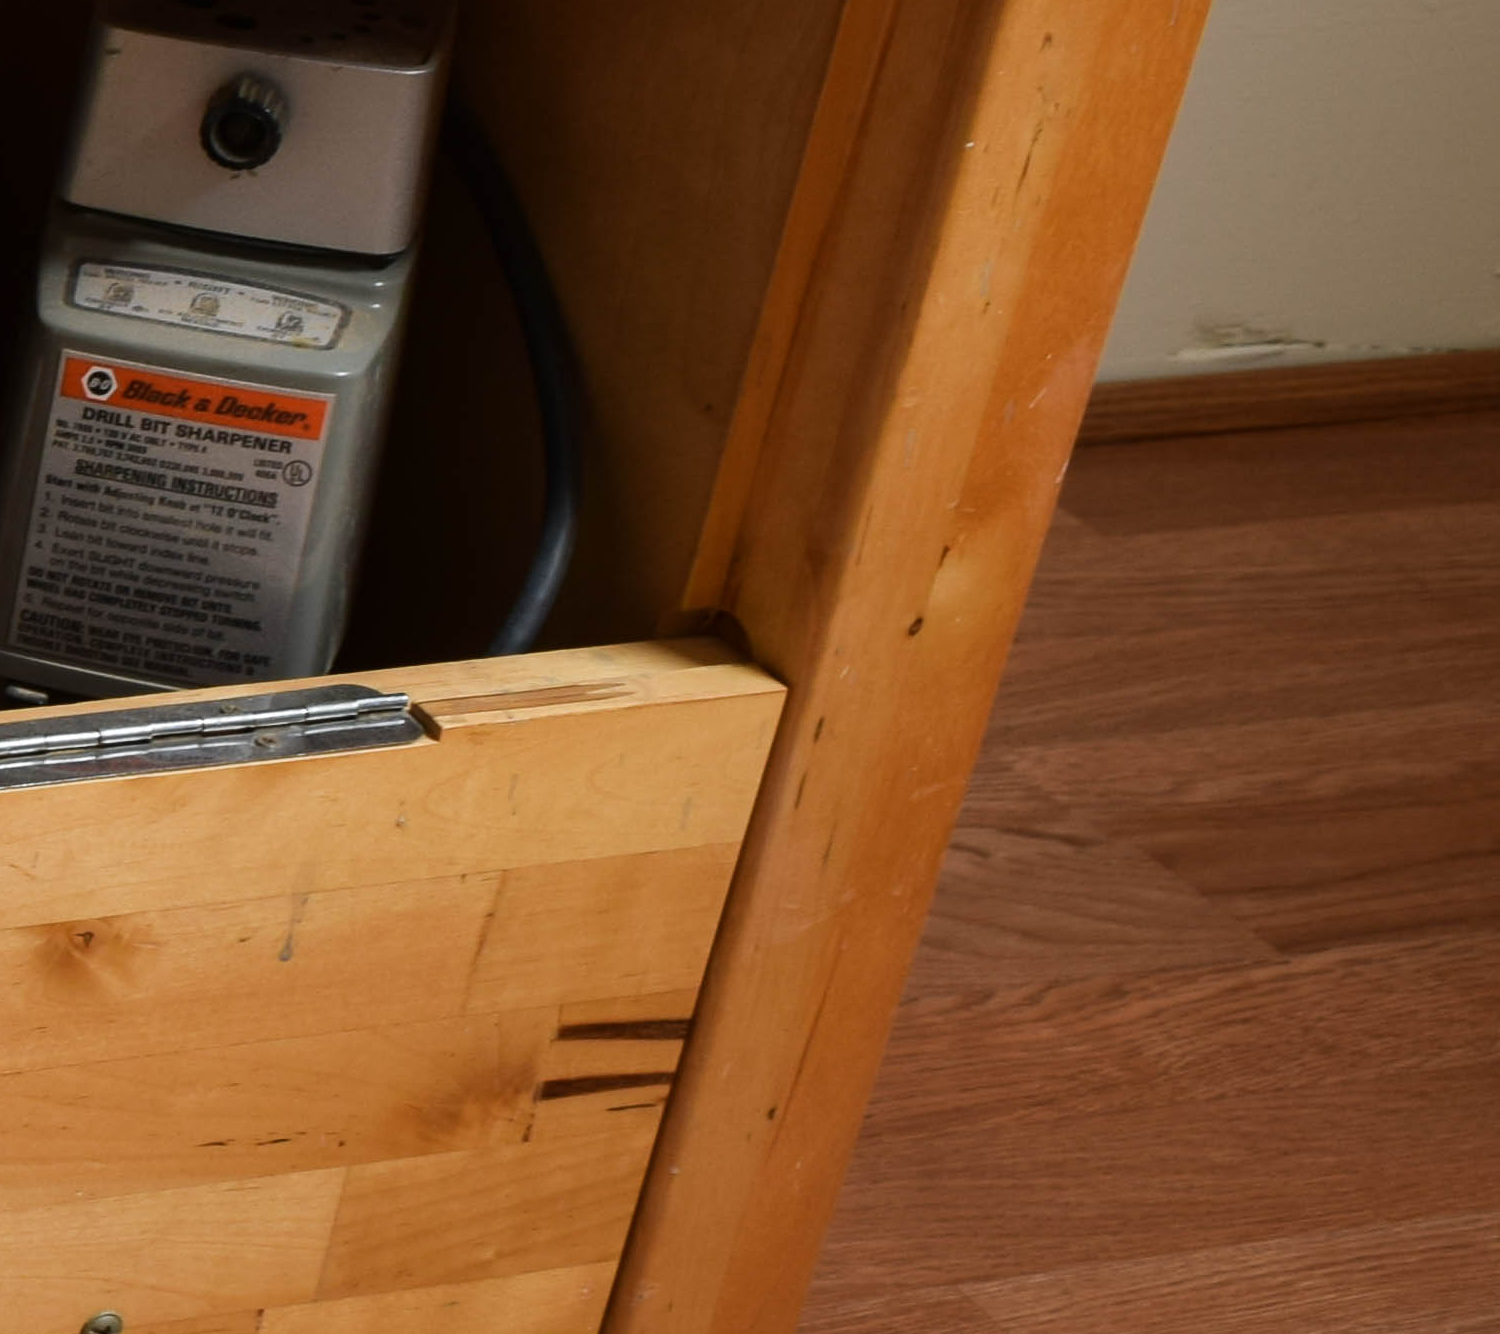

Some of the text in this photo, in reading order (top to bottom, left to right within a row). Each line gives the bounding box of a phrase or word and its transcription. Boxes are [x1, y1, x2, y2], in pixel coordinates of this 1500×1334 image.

[122, 377, 192, 409] Black
[82, 406, 293, 455] DRILL BIT SHARPENER
[74, 458, 167, 489] SHARPENING
[170, 476, 279, 508] INSTRUCTIONS
